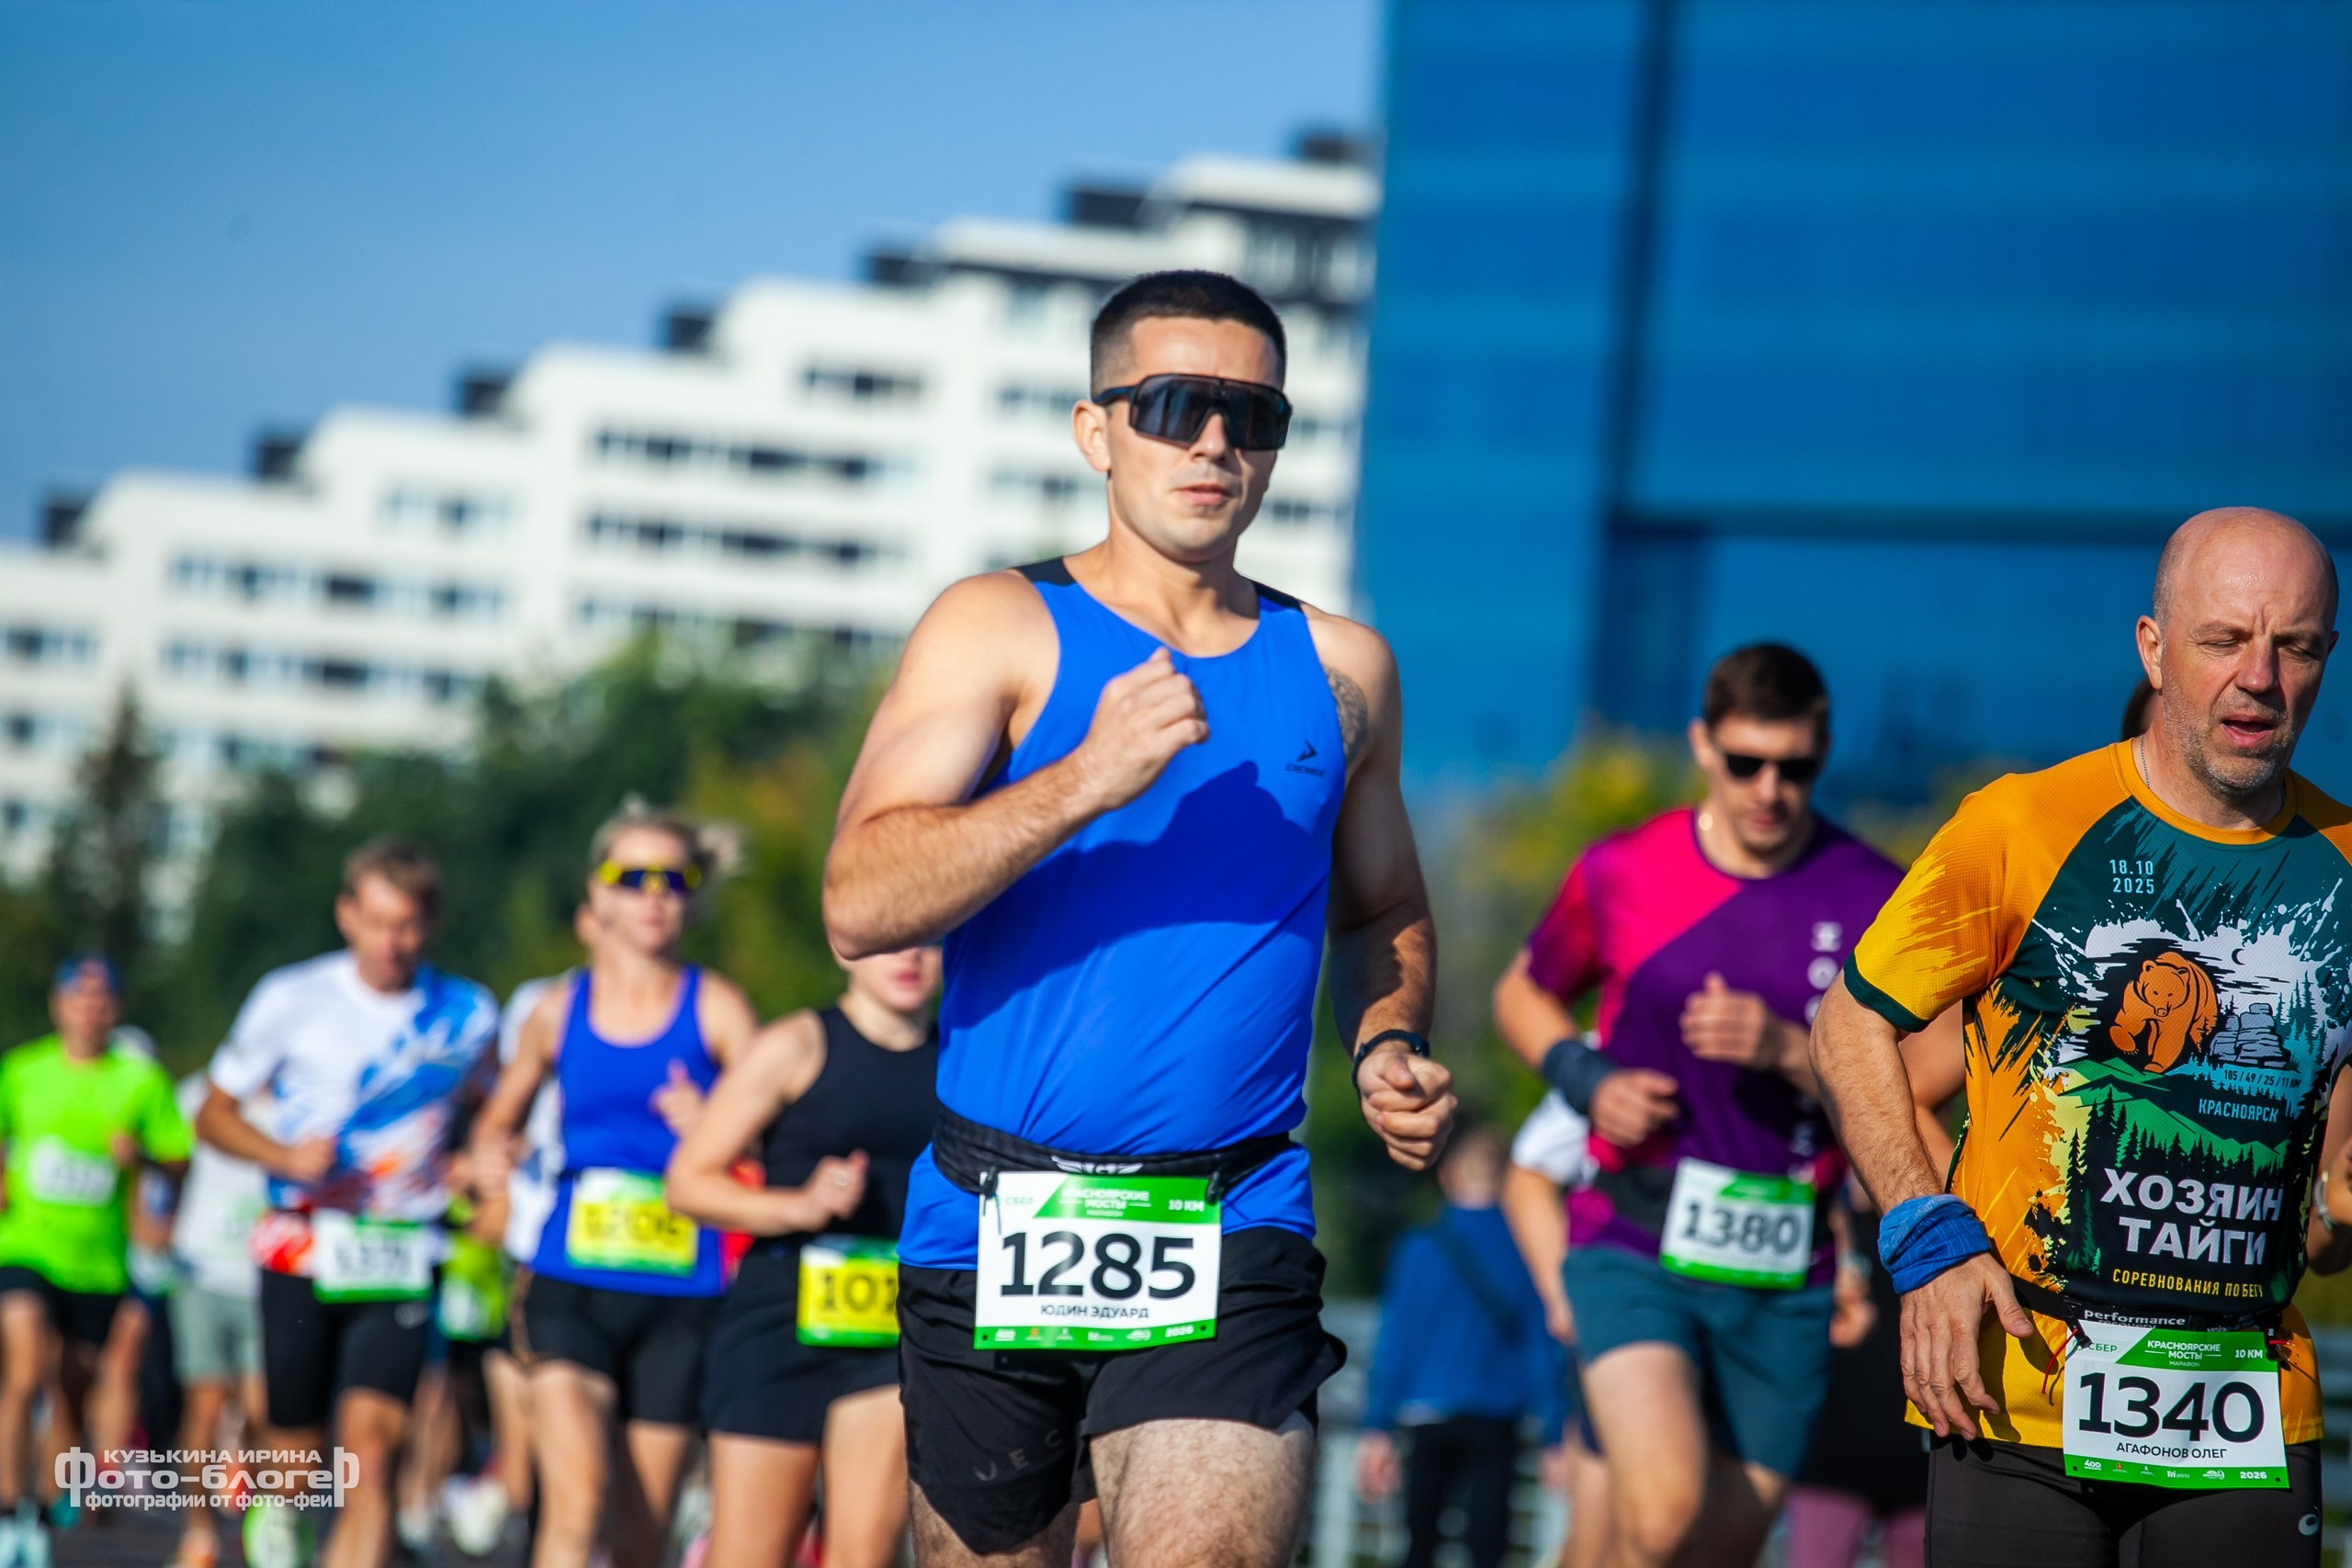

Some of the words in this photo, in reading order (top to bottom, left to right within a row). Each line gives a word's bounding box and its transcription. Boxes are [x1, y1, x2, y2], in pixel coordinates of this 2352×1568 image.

[2109, 860, 2154, 874] 18.10
[2113, 877, 2154, 894] 2025
[2224, 1069, 2238, 1081] 105
[2245, 1073, 2256, 1083] 49
[2264, 1075, 2275, 1086] 25
[2199, 1099, 2279, 1122] КРАСНОЯРСК
[2100, 1168, 2283, 1221] ХОЗЯИН
[1169, 1199, 1182, 1210] 10
[1681, 1201, 1801, 1257] 1380
[2119, 1216, 2267, 1265] ТАЙГИ
[1001, 1231, 1195, 1301] 1285
[2113, 1269, 2220, 1295] СОРЕВНОВАНИЯ
[2225, 1282, 2240, 1297] ПО
[1041, 1304, 1087, 1316] ЮДИН
[1091, 1306, 1148, 1319] ЭДУАРД
[2084, 1310, 2186, 1325] performance
[2147, 1340, 2221, 1352] КРАСНОЯРСКИЕ
[2168, 1350, 2202, 1359] МОСТЫ
[2235, 1349, 2245, 1359] 10
[2079, 1371, 2265, 1443] 1340
[2116, 1442, 2188, 1459] АГАФОНОВ
[2191, 1449, 2227, 1459] ОЛЕГ
[2239, 1471, 2267, 1480] 2026
